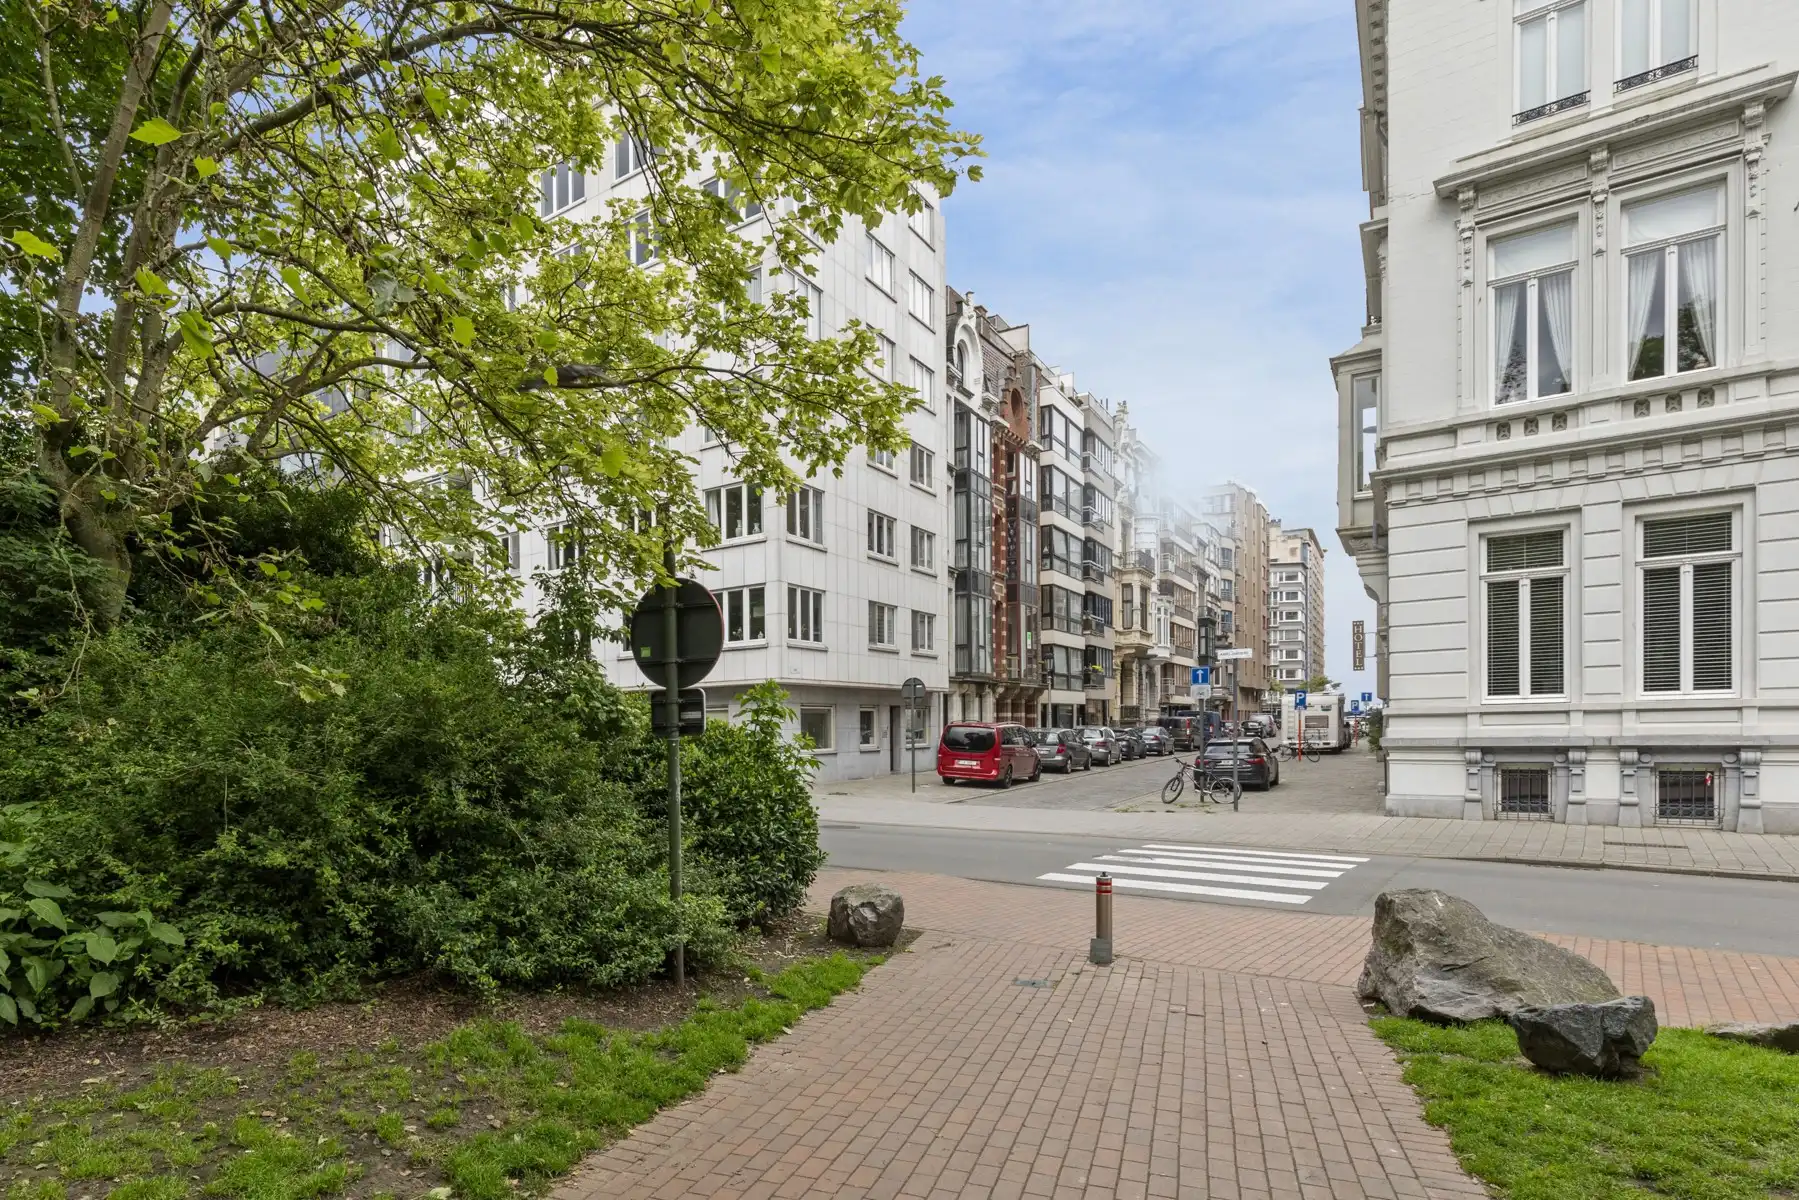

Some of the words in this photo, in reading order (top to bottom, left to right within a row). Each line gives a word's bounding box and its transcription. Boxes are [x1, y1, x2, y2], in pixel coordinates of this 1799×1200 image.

[1354, 625, 1363, 666] HOTEL
[1296, 692, 1305, 703] P
[1352, 701, 1358, 709] P
